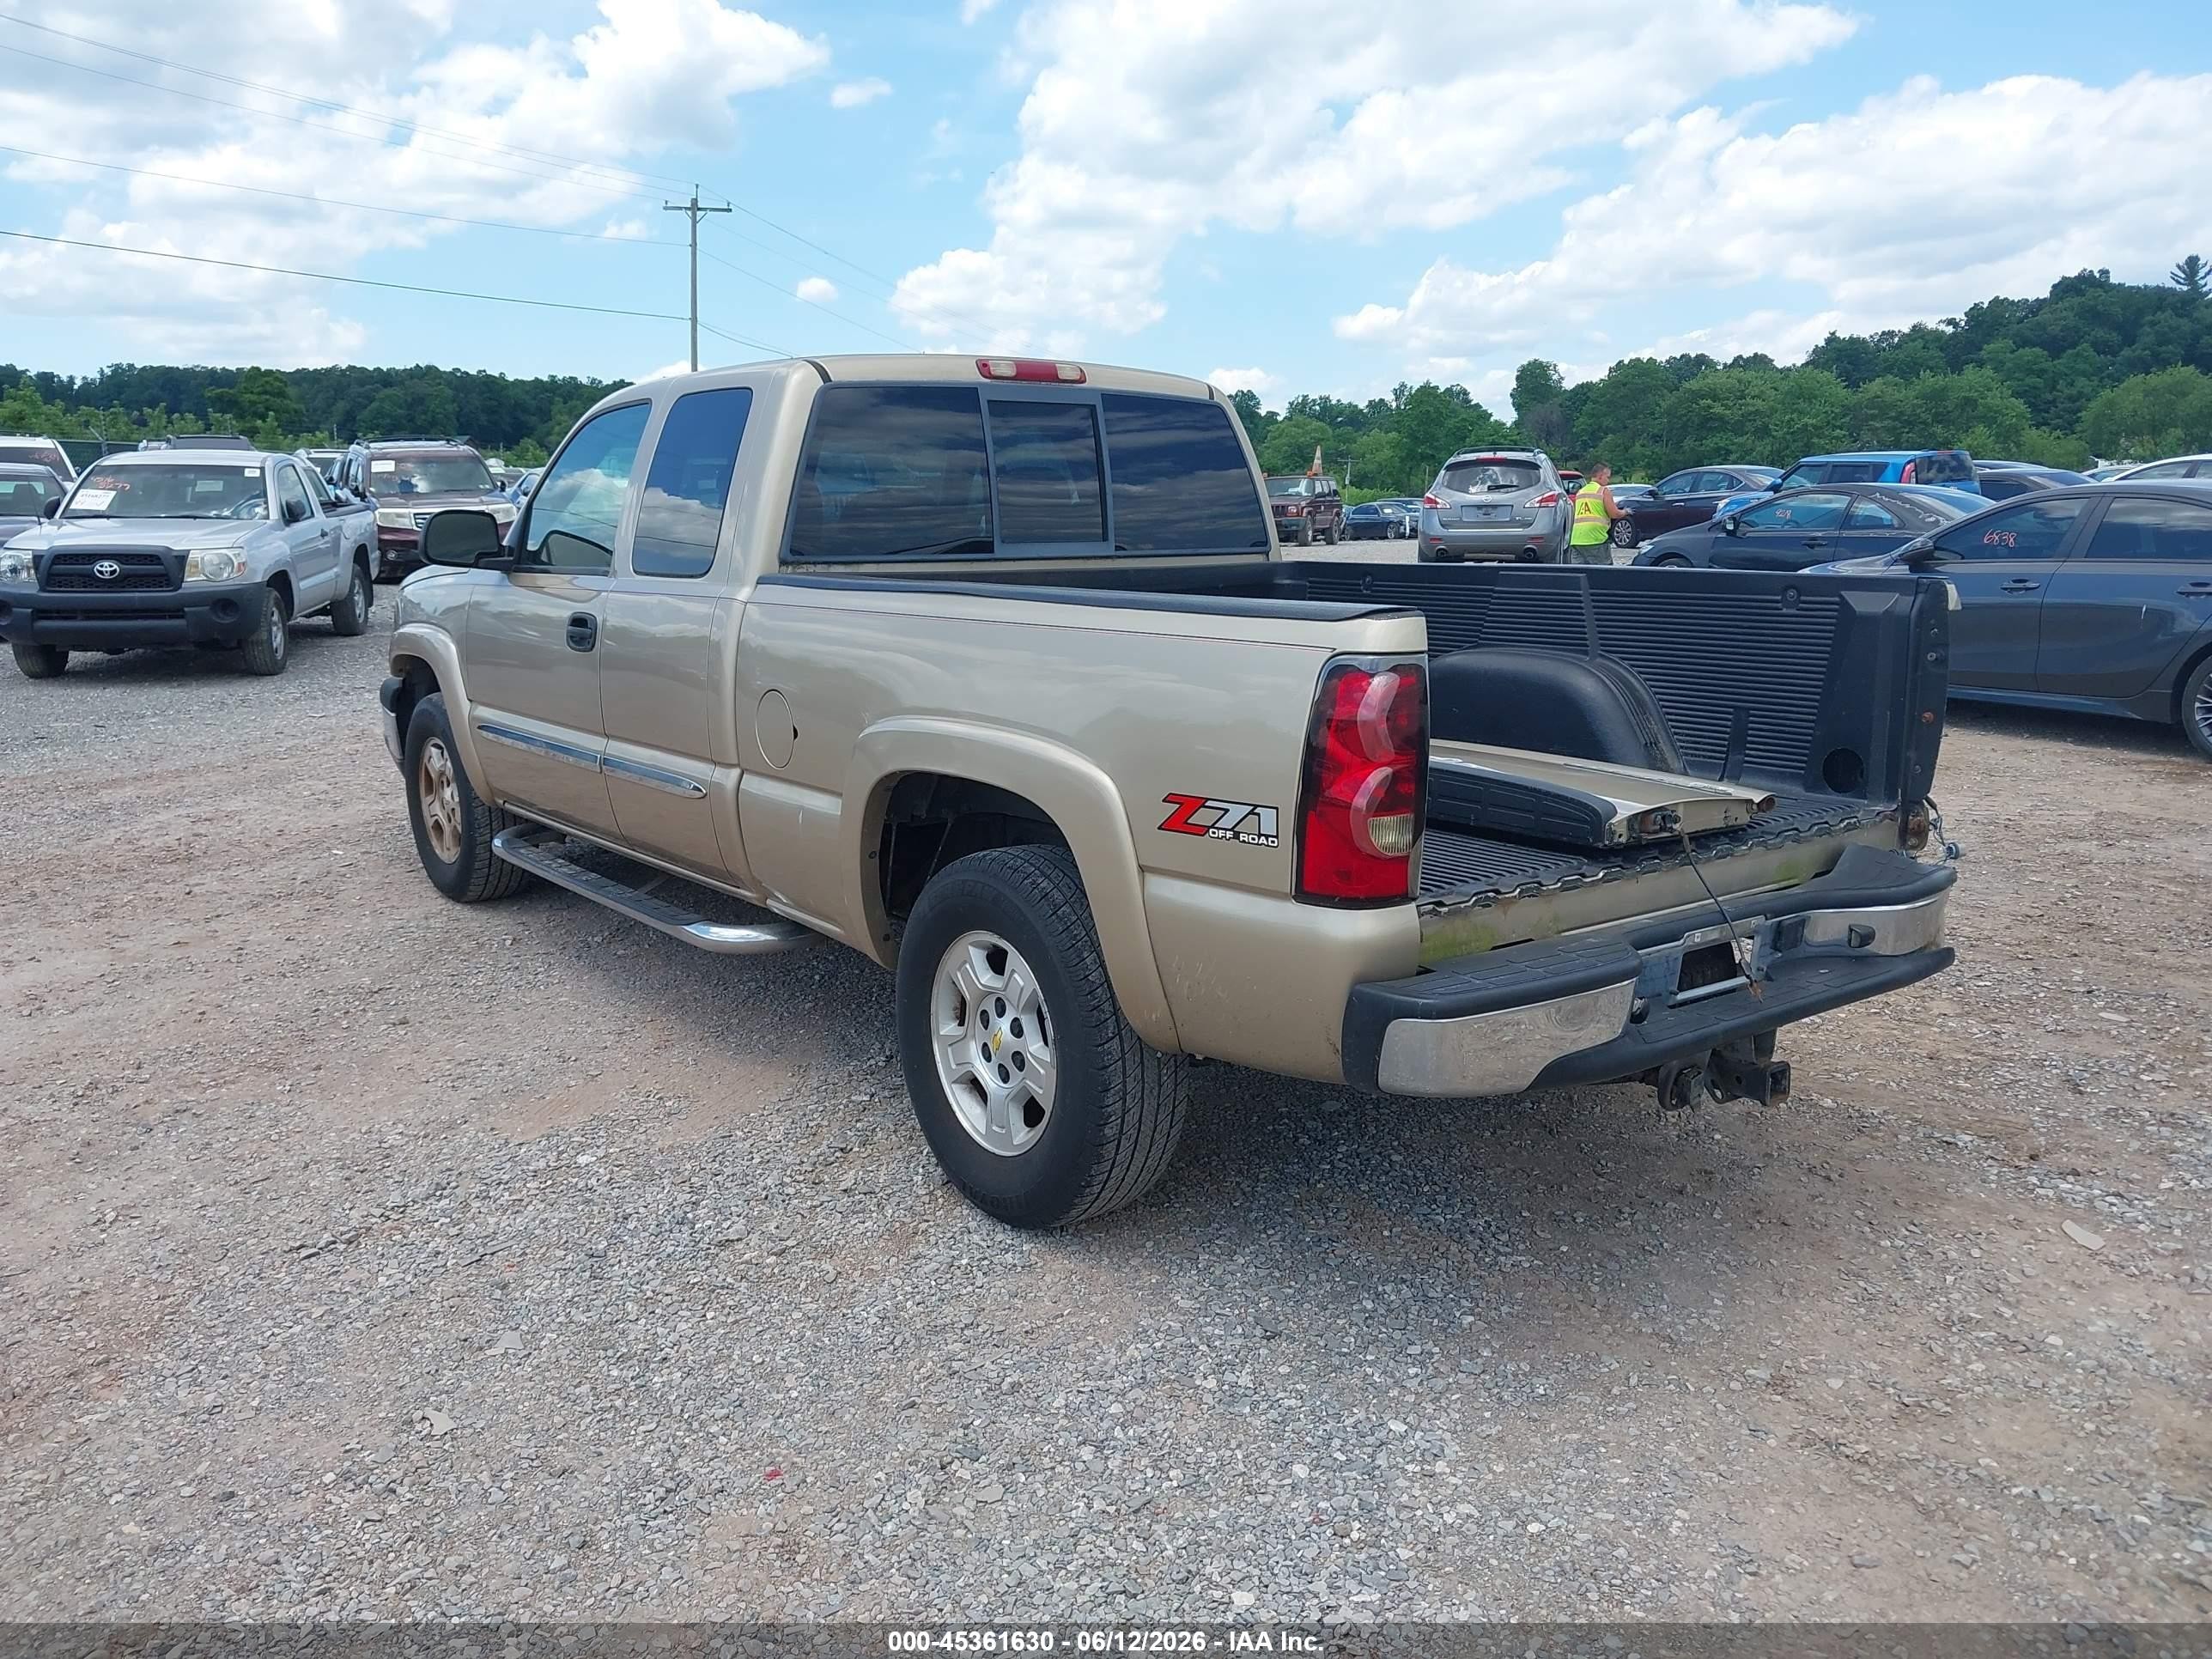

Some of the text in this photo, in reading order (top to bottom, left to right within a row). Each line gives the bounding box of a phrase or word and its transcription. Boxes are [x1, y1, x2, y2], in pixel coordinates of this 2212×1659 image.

[1984, 529, 2017, 547] 6838
[1158, 793, 1279, 837] Z71
[1208, 828, 1279, 848] OFF ROAD
